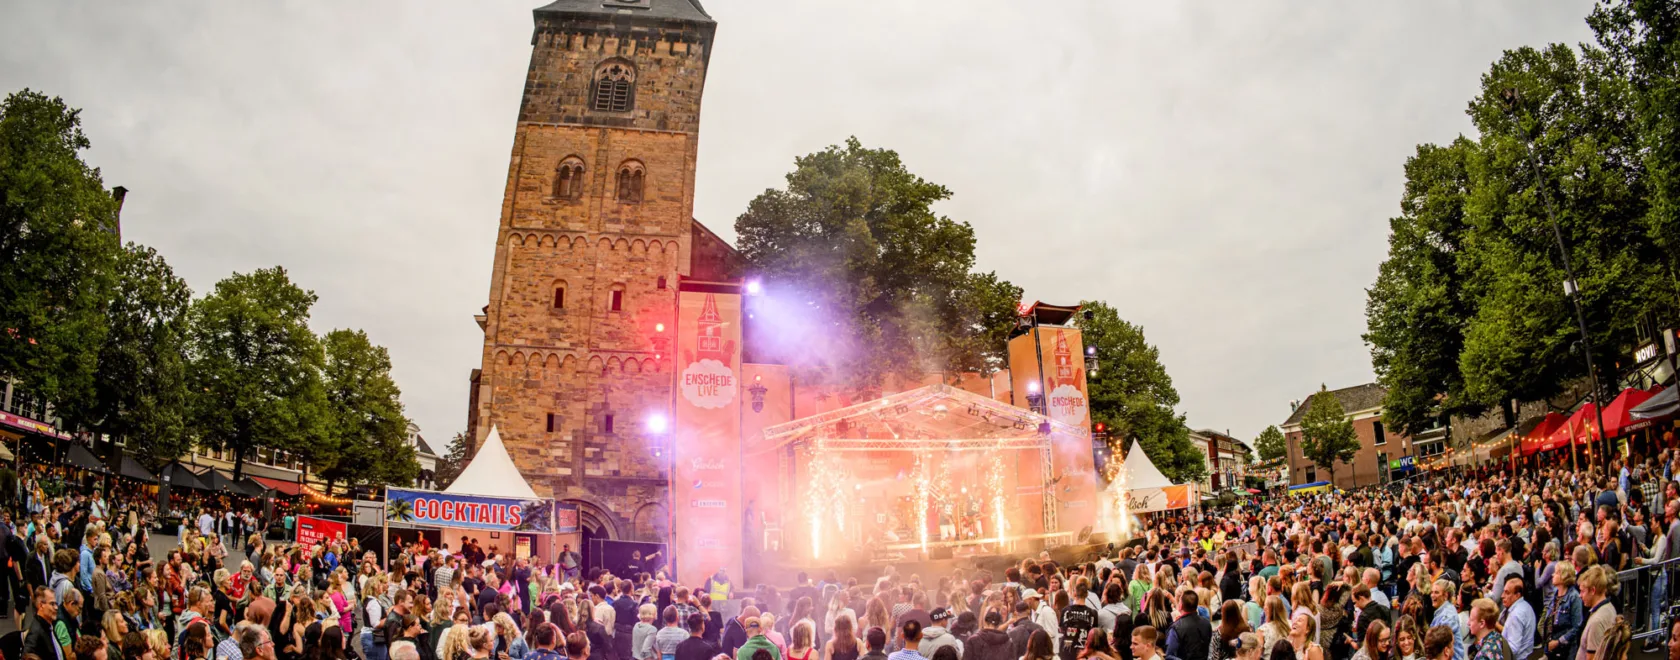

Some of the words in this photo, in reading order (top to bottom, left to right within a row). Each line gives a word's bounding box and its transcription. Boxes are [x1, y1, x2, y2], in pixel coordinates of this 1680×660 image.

[686, 373, 732, 387] ENSCHEDE
[697, 385, 718, 397] LIVE
[1052, 396, 1083, 407] ENSCHEDE
[1061, 406, 1076, 416] LIVE
[1399, 456, 1413, 467] WC
[1128, 496, 1149, 510] lsch
[413, 497, 523, 526] COCKTAILS
